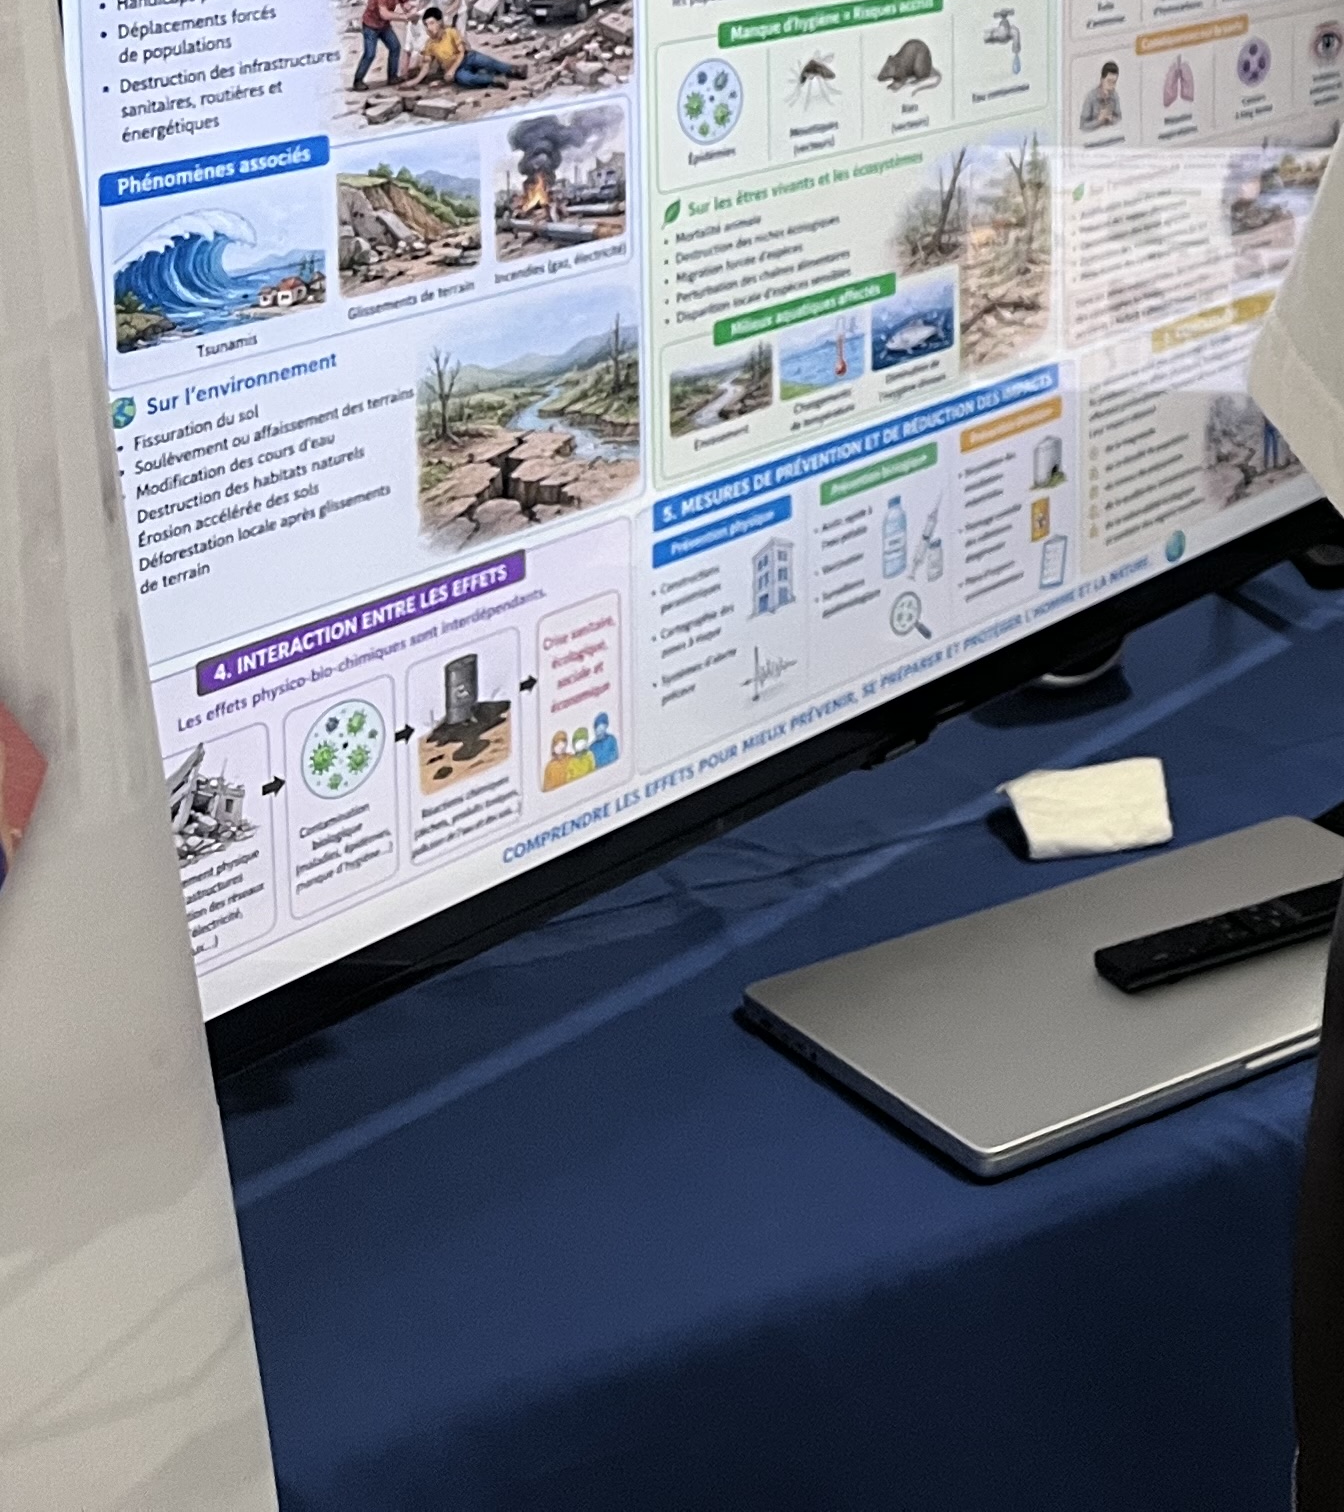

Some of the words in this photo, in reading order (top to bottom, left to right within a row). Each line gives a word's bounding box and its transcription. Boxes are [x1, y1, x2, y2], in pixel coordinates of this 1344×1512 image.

[118, 14, 227, 40] Déplacements
[232, 6, 277, 23] forcés
[119, 47, 138, 63] de
[143, 37, 232, 64] populations
[120, 71, 206, 93] Destruction
[210, 65, 235, 80] des
[239, 51, 340, 75] infrastructures
[121, 97, 196, 118] sanitaires,
[200, 85, 265, 105] routières
[269, 81, 282, 94] et
[122, 116, 220, 142] énergétiques
[117, 163, 235, 195] Phénomènes
[239, 145, 311, 173] associés
[196, 335, 258, 357] Tsunamis
[147, 396, 178, 415] Sur
[185, 353, 336, 405] l'environnement
[134, 421, 212, 451] Fissuration
[216, 413, 235, 428] du
[239, 404, 259, 422] sol
[135, 438, 228, 475] Soulèvement
[232, 435, 250, 447] ou
[254, 408, 339, 442] affaissement
[342, 403, 364, 417] des
[367, 389, 414, 409] terrains
[137, 466, 225, 499] Modification
[230, 457, 254, 472] des
[258, 445, 295, 464] cours
[299, 434, 335, 452] d'eau
[137, 491, 221, 524] Destruction
[225, 482, 249, 497] des
[253, 465, 307, 489] habitats
[312, 447, 365, 471] naturels
[138, 523, 191, 548] Érosion
[195, 501, 262, 530] accélérée
[266, 493, 290, 509] des
[294, 483, 319, 501] sols
[140, 580, 158, 594] de
[162, 563, 210, 587] terrain
[214, 663, 232, 680] 4.
[237, 616, 357, 674] INTERACTION
[362, 595, 416, 630] ENTRE
[420, 584, 448, 609] LES
[452, 564, 507, 597] EFFETS
